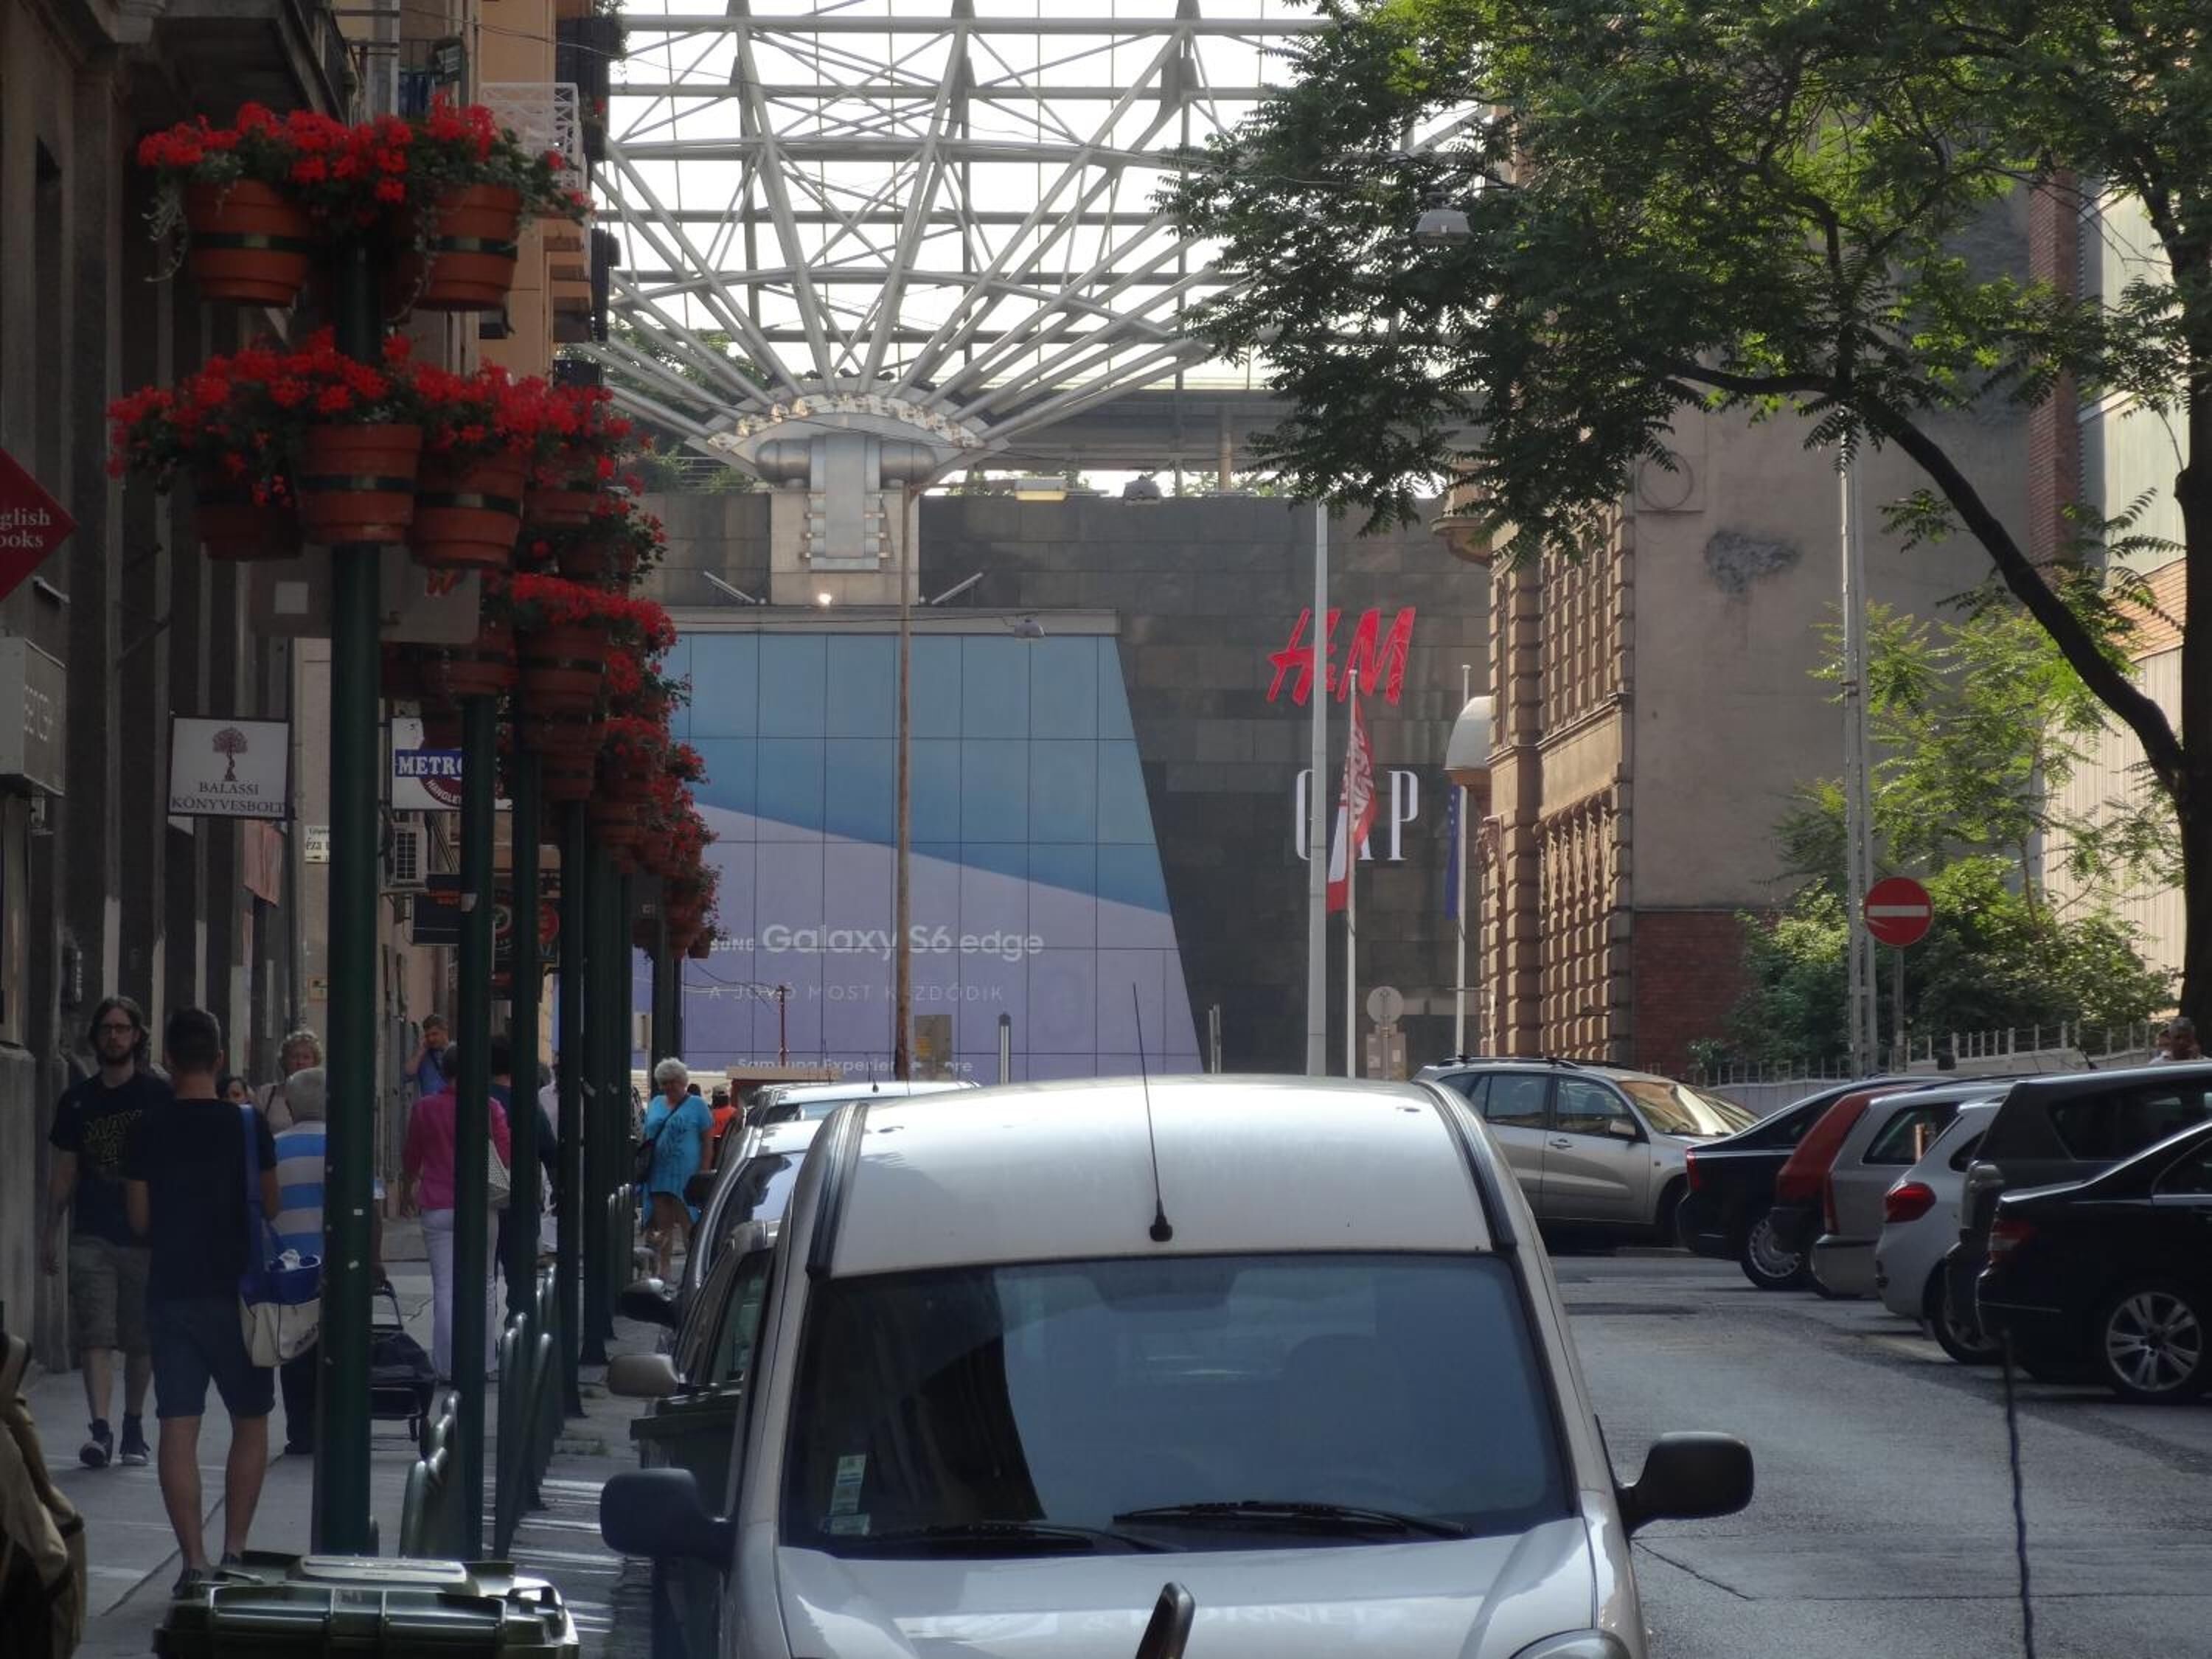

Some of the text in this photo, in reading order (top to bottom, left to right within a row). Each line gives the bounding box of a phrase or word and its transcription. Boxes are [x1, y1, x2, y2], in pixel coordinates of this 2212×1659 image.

[398, 756, 462, 775] METR
[199, 782, 260, 796] BALASSI
[762, 924, 897, 961] Galaxy
[909, 925, 953, 954] S6
[960, 931, 1044, 962] edge
